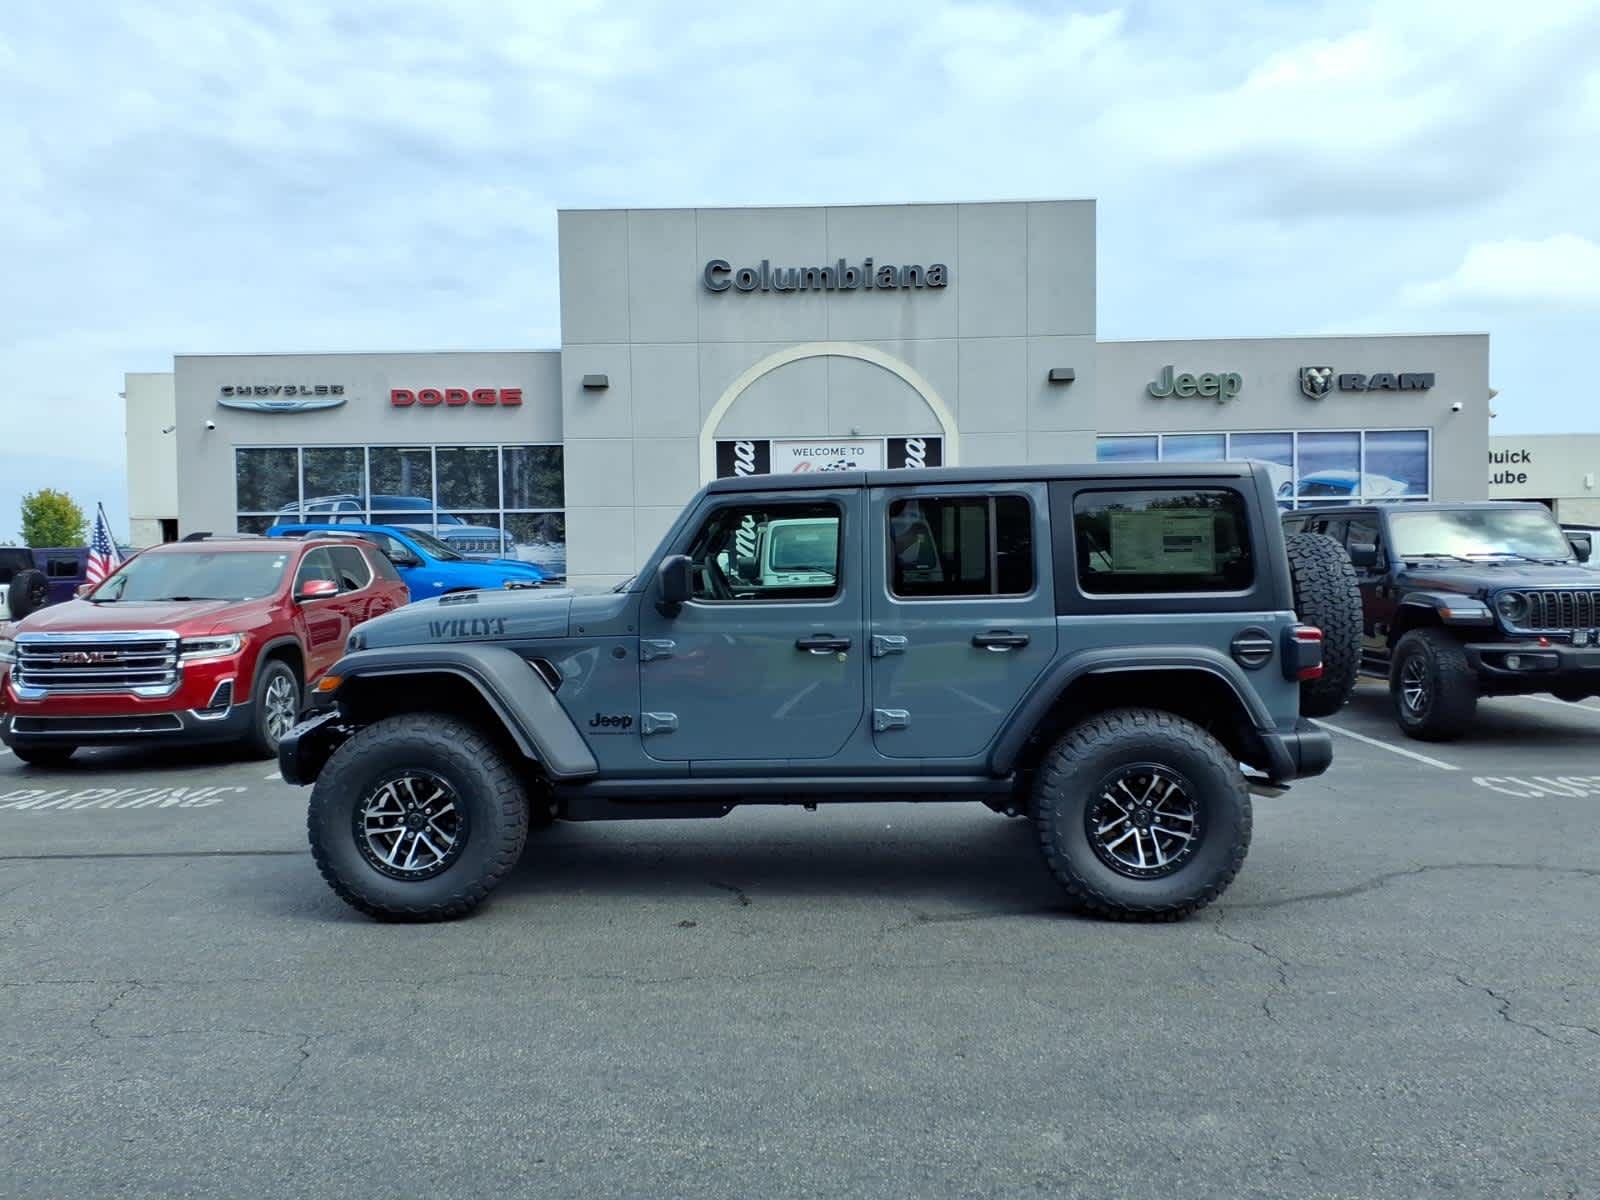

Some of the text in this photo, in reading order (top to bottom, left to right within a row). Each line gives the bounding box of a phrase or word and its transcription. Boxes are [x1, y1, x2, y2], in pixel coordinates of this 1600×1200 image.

[704, 257, 949, 292] Columbiana
[220, 384, 345, 397] CHRYSLER
[1149, 366, 1242, 403] Jeep
[1339, 373, 1435, 392] RAM
[390, 387, 523, 407] DODGE
[792, 447, 865, 457] WELCOME TO
[1488, 470, 1528, 484] ube
[428, 617, 508, 638] WILLYS
[589, 712, 633, 729] Jeep
